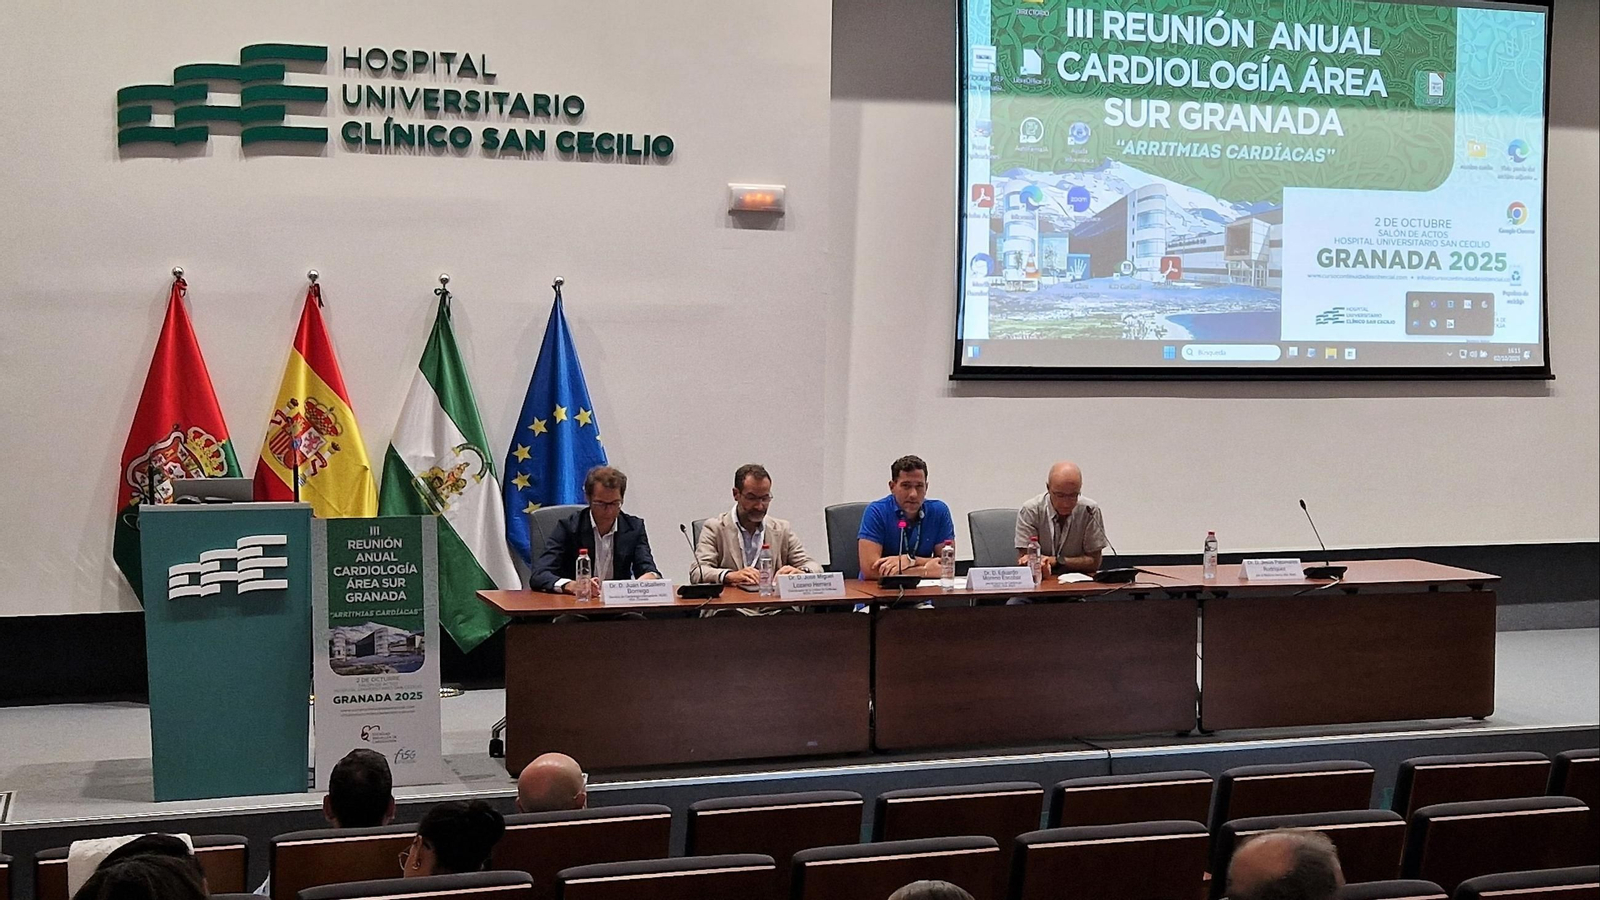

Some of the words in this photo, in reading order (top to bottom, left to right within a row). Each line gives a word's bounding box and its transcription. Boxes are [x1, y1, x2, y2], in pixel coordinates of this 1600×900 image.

[1067, 8, 1094, 38] III
[1103, 10, 1254, 48] REUNIÓN
[1269, 21, 1382, 56] ANUAL
[343, 46, 497, 78] HOSPITAL
[1057, 53, 1293, 93] CARDIOLOGÍA
[1300, 57, 1388, 98] ÁREA
[342, 84, 585, 118] UNIVERSITARIO
[1104, 98, 1170, 129] SUR
[1178, 100, 1345, 137] GRANADA
[341, 116, 472, 149] CLÍNICO
[481, 127, 546, 152] SAN
[555, 131, 674, 157] CECILIO
[1374, 217, 1381, 227] 2
[1383, 218, 1398, 228] DE
[1400, 218, 1452, 229] OCTUBRE
[1378, 228, 1406, 238] SALÓN
[1408, 230, 1420, 238] DE
[1421, 230, 1449, 239] ACTOS
[1334, 237, 1375, 246] HOSPITAL
[1376, 238, 1439, 247] UNIVERSITARIO
[1441, 239, 1458, 248] SAN
[1459, 240, 1491, 249] CECILIO
[1317, 248, 1442, 271] GRANADA
[1449, 251, 1507, 272] 2025
[369, 526, 380, 536] III
[347, 536, 403, 550] REUNIÓN
[355, 552, 398, 563] ANUAL
[333, 562, 418, 577] CARDIOLOGÍA
[346, 577, 380, 589] ÁREA
[382, 577, 406, 588] SUR
[345, 591, 407, 603] GRANADA
[333, 693, 392, 705] GRANADA
[394, 691, 423, 701] 2025
